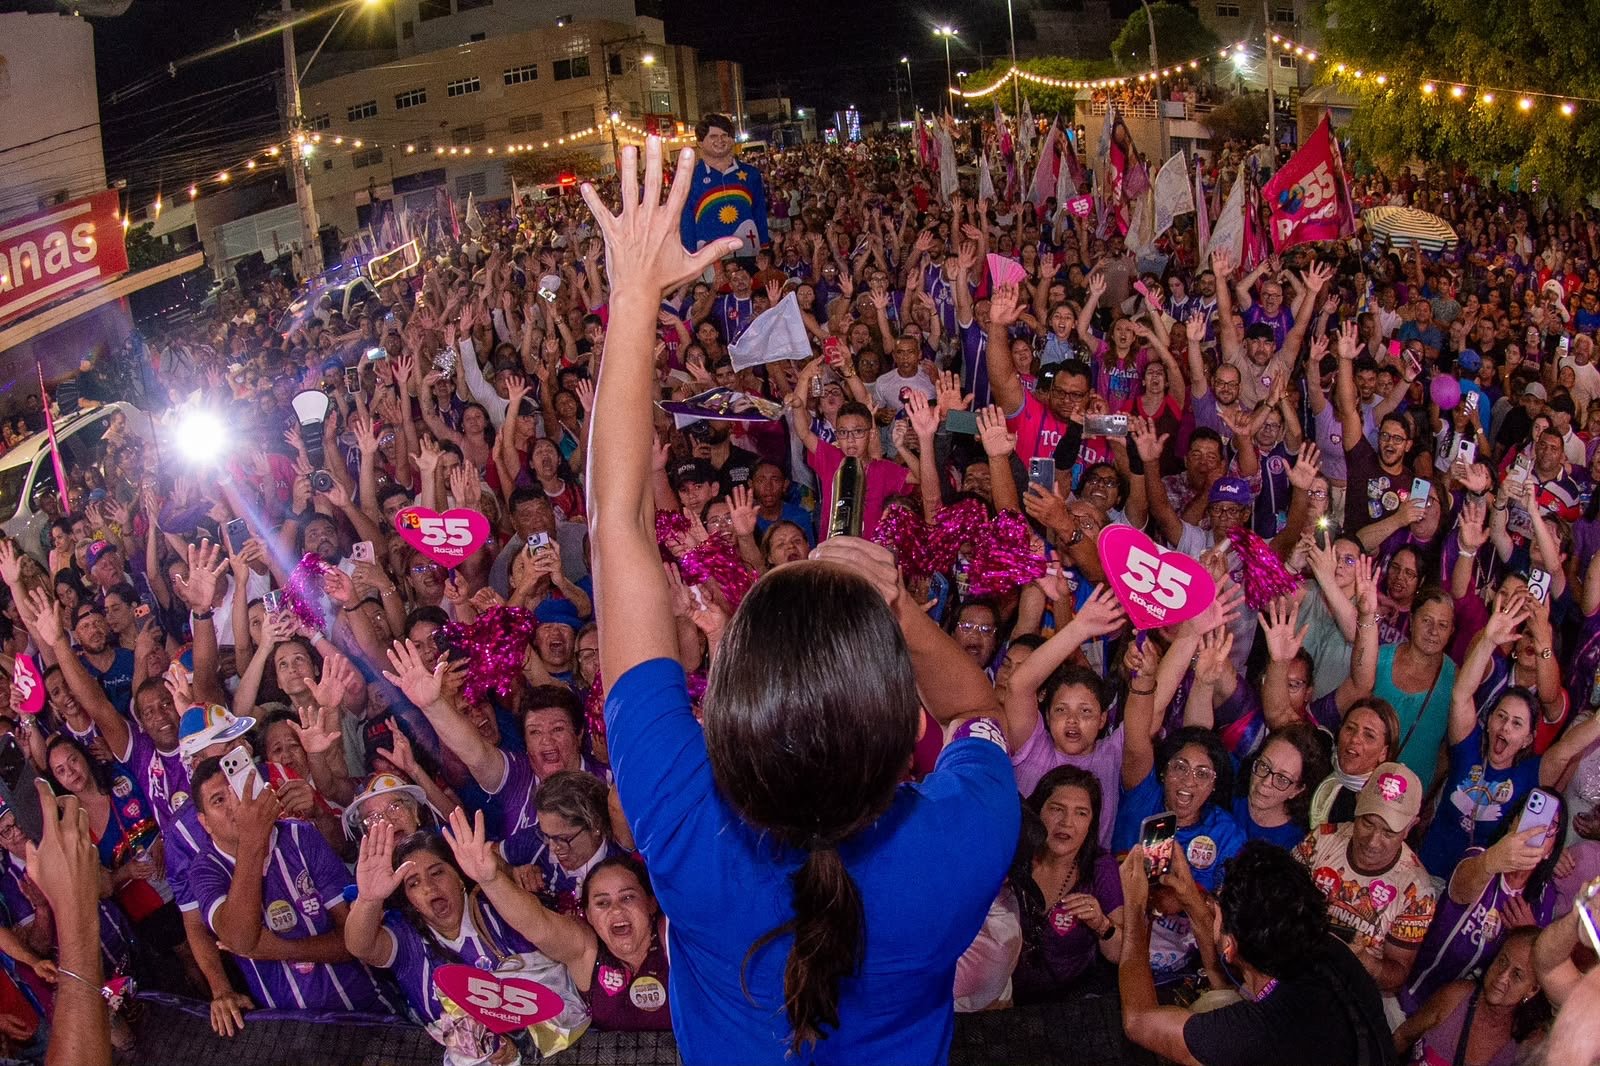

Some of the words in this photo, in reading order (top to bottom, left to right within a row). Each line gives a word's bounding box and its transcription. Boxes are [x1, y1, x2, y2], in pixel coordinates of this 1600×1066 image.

[1304, 161, 1335, 208] 55
[1072, 199, 1089, 212] 55
[420, 518, 473, 546] 55
[433, 547, 464, 556] Raquel
[1120, 545, 1192, 610] 55
[1128, 591, 1167, 618] Raquel
[1371, 884, 1392, 902] 55
[302, 898, 320, 912] 55
[603, 970, 624, 987] 55
[465, 976, 539, 1016] 55
[480, 1008, 522, 1021] Raquel
